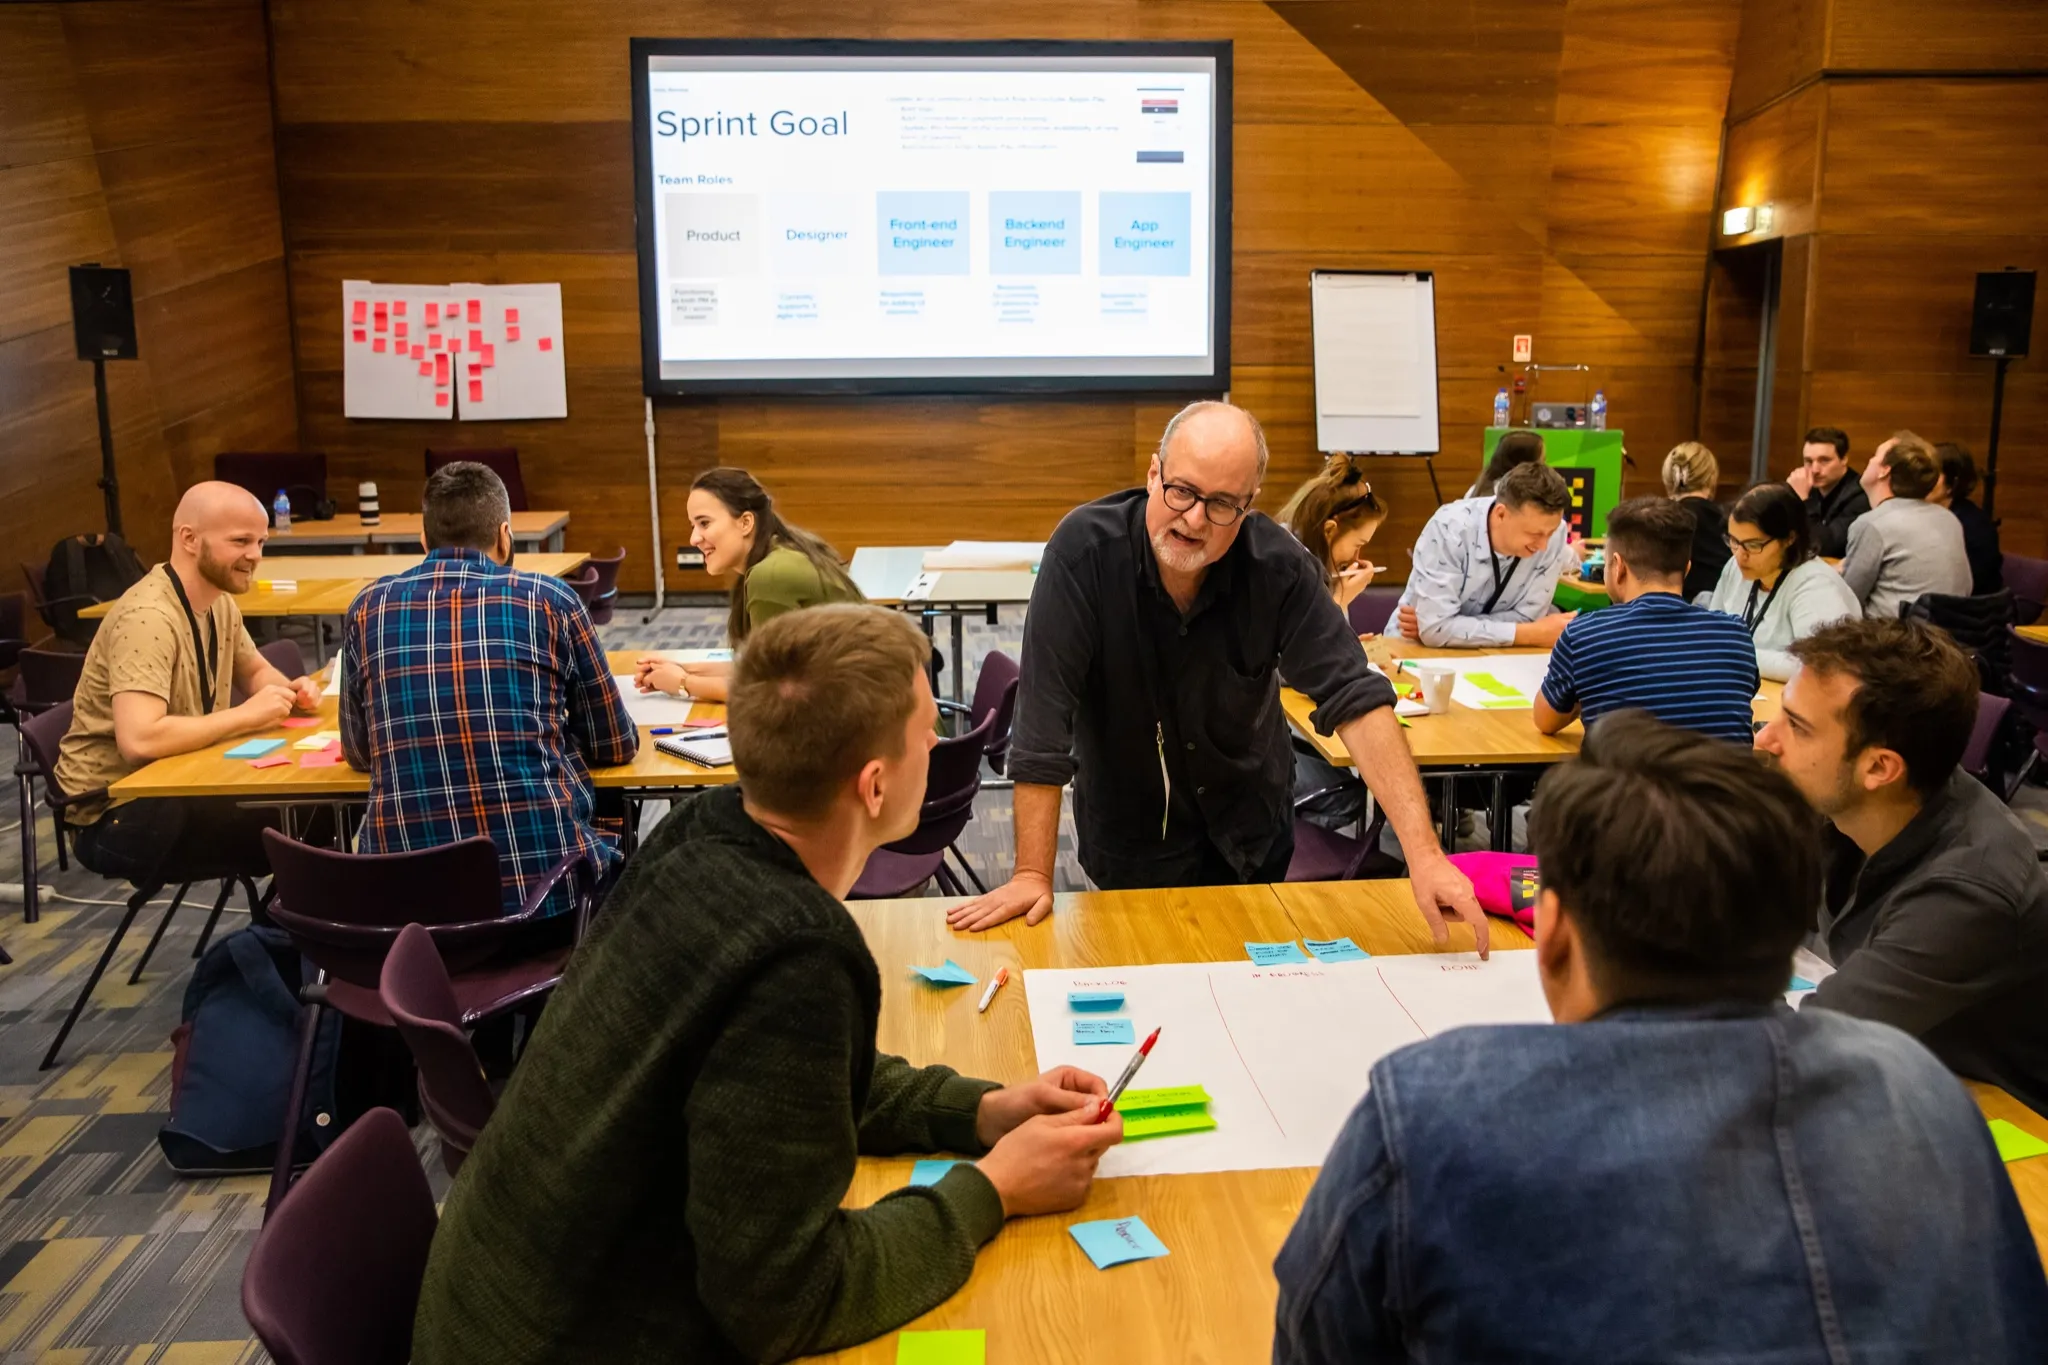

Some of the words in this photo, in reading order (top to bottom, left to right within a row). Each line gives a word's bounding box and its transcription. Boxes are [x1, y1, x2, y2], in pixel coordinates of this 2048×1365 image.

[657, 110, 758, 142] Sprint
[771, 110, 847, 136] Goal
[658, 174, 693, 185] Team
[697, 174, 733, 185] Roles
[890, 218, 957, 231] Front-end
[1005, 218, 1065, 231] Backend
[1130, 219, 1159, 233] App
[686, 229, 741, 242] Product
[786, 229, 848, 242] Designer
[892, 236, 955, 251] Engineer
[1004, 236, 1066, 251] Engineer
[1114, 236, 1175, 251] Engineer
